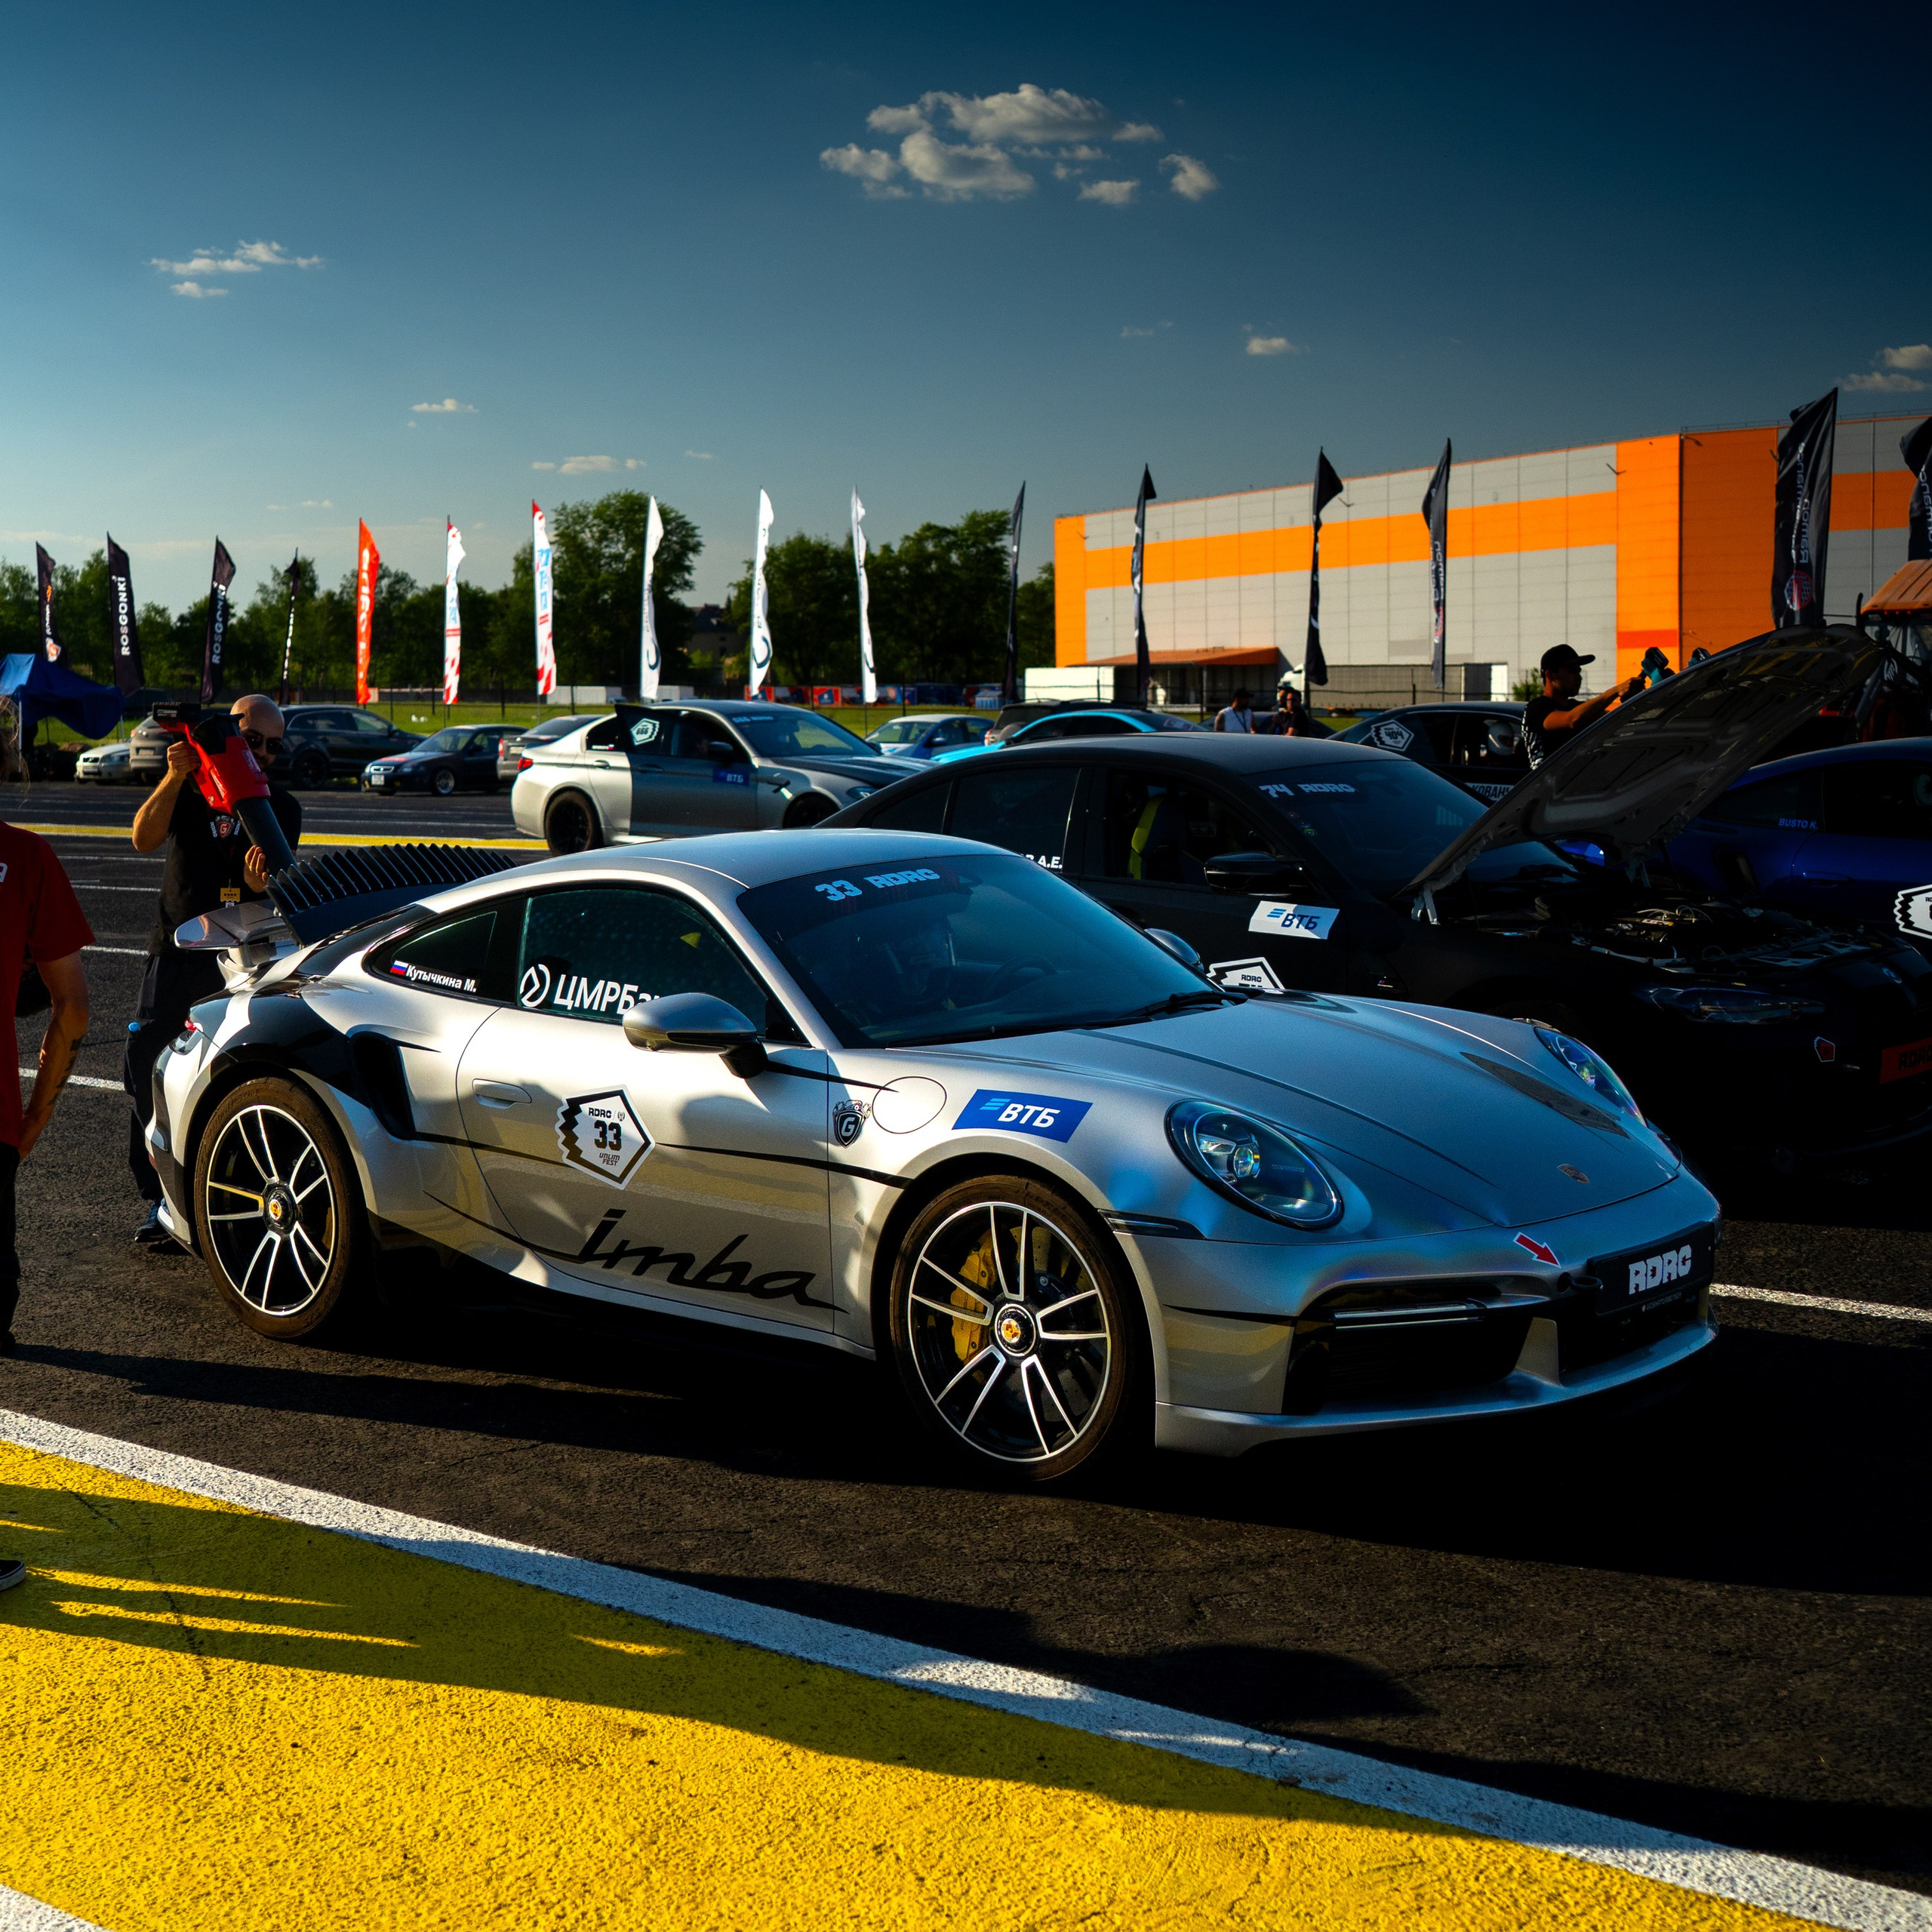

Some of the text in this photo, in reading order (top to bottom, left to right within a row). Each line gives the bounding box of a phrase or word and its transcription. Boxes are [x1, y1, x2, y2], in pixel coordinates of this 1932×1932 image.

[117, 576, 131, 657] ROSGONKI
[1385, 731, 1404, 740] 404
[728, 773, 745, 784] ВТБ
[1258, 783, 1357, 798] 74 RDRC
[1779, 817, 1808, 829] BUSTO
[815, 869, 940, 901] 33 RDRC
[1281, 913, 1321, 930] ВТБ
[406, 964, 477, 993] Кутычкина М.
[1241, 974, 1263, 983] RDRC
[554, 974, 660, 1016] ЦМРБ
[588, 1107, 612, 1118] RDRC
[997, 1103, 1061, 1128] ВТБ
[594, 1119, 623, 1152] 33
[841, 1117, 856, 1137] G
[570, 1208, 848, 1312] imba
[1629, 1244, 1692, 1295] RDRC
